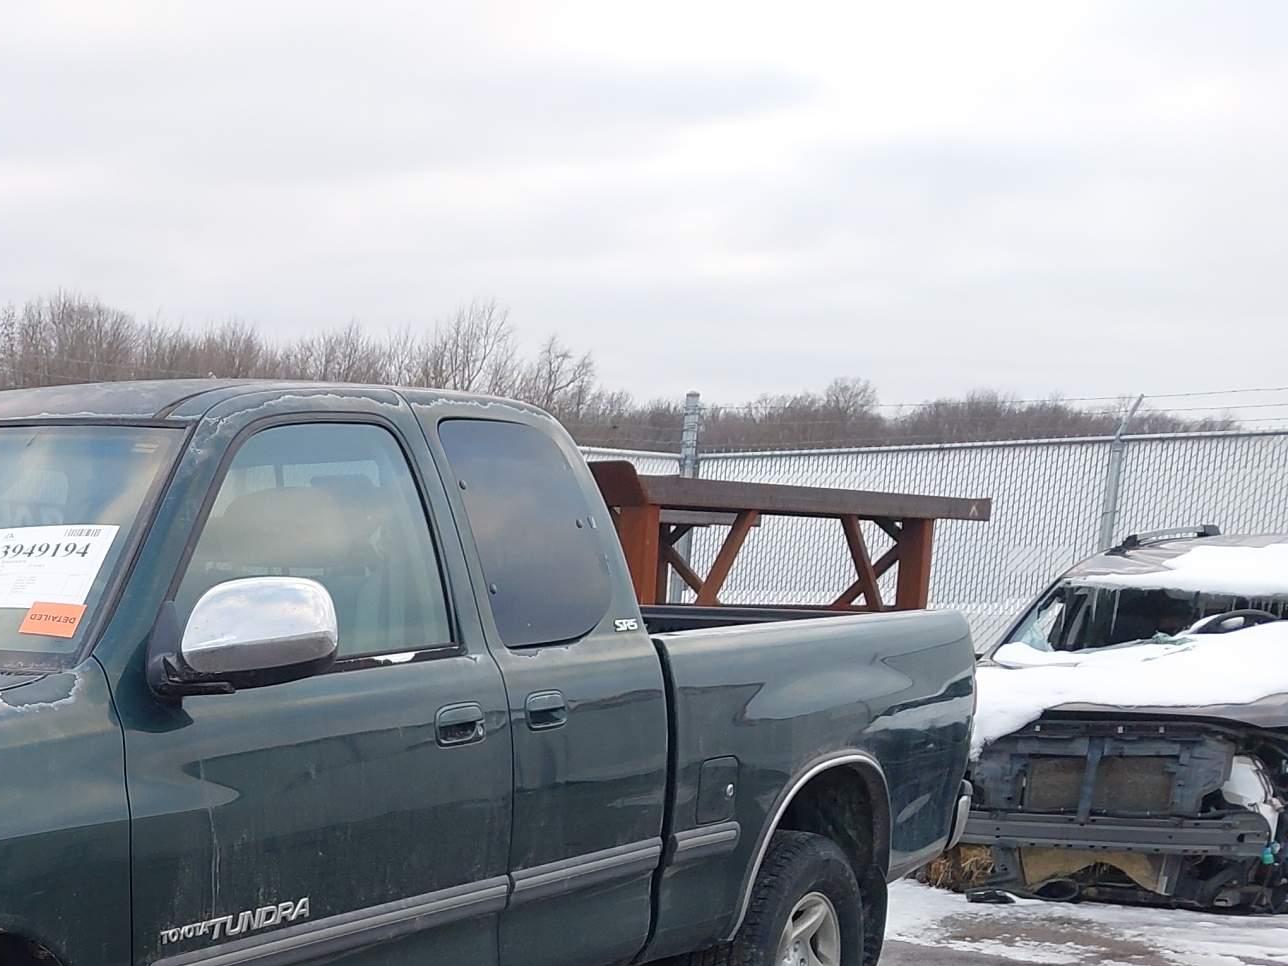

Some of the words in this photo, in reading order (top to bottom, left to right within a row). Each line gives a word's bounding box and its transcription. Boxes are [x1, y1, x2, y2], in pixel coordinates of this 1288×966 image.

[29, 613, 76, 625] DETAILED
[160, 921, 210, 945] TOYOTA
[210, 897, 310, 940] TUNDRA
